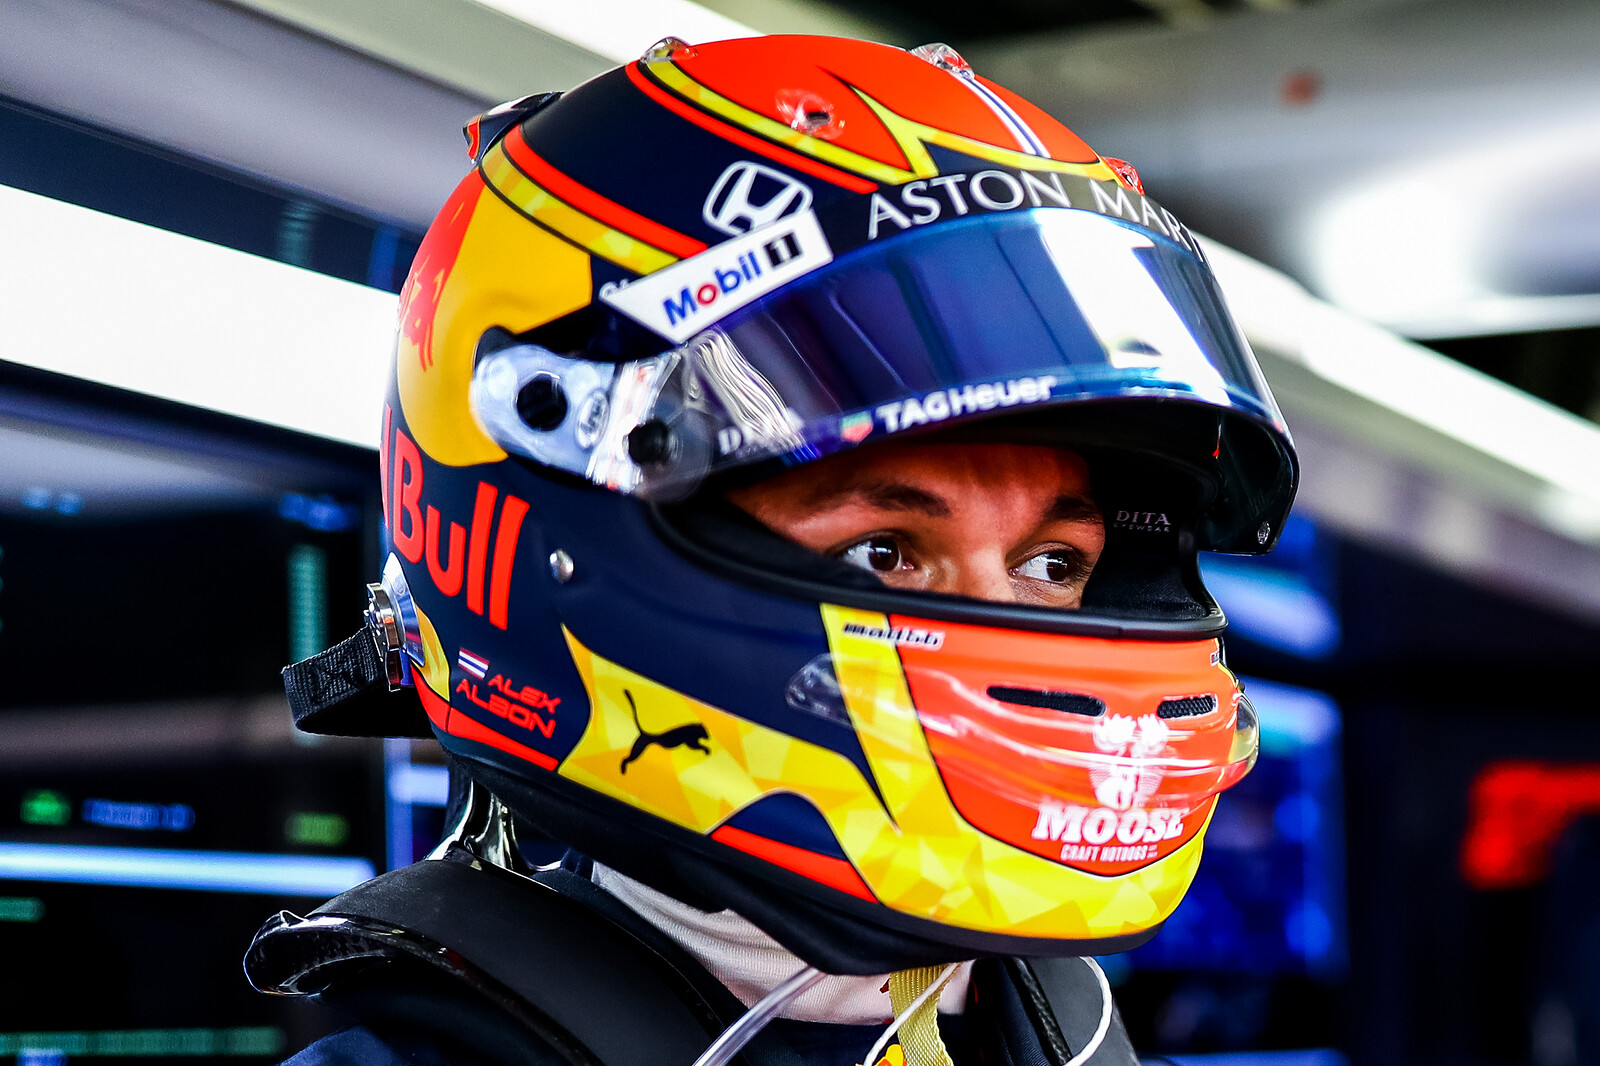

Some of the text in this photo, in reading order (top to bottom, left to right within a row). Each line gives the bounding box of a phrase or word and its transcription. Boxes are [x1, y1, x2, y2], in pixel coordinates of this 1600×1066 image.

[867, 169, 1205, 263] ASTON MART
[662, 250, 763, 327] Mobil
[392, 427, 531, 631] Bull
[1116, 510, 1171, 526] DITA
[455, 678, 557, 739] ALBON
[487, 673, 562, 715] ALEX
[1031, 802, 1189, 845] MOOSE
[1060, 843, 1100, 863] CRAFT
